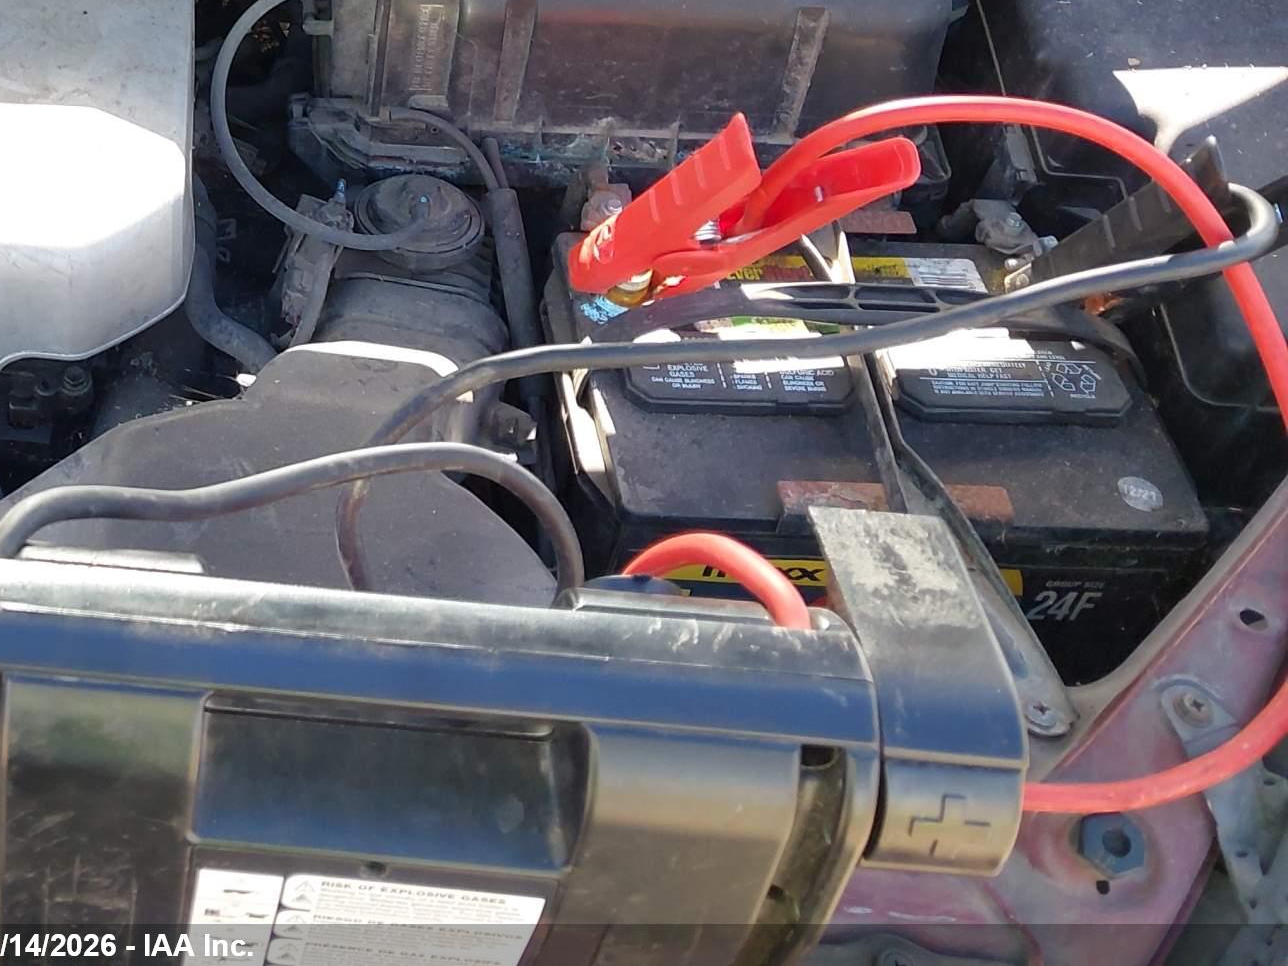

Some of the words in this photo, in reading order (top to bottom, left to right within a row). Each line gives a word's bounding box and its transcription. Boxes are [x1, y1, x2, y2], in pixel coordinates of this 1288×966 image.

[667, 364, 709, 372] EXPLOSIVE
[1123, 484, 1157, 502] 12/21
[1026, 590, 1103, 621] 24F
[321, 881, 352, 890] RISK
[380, 887, 455, 900] EXPLOSIVE
[461, 895, 506, 905] GASES
